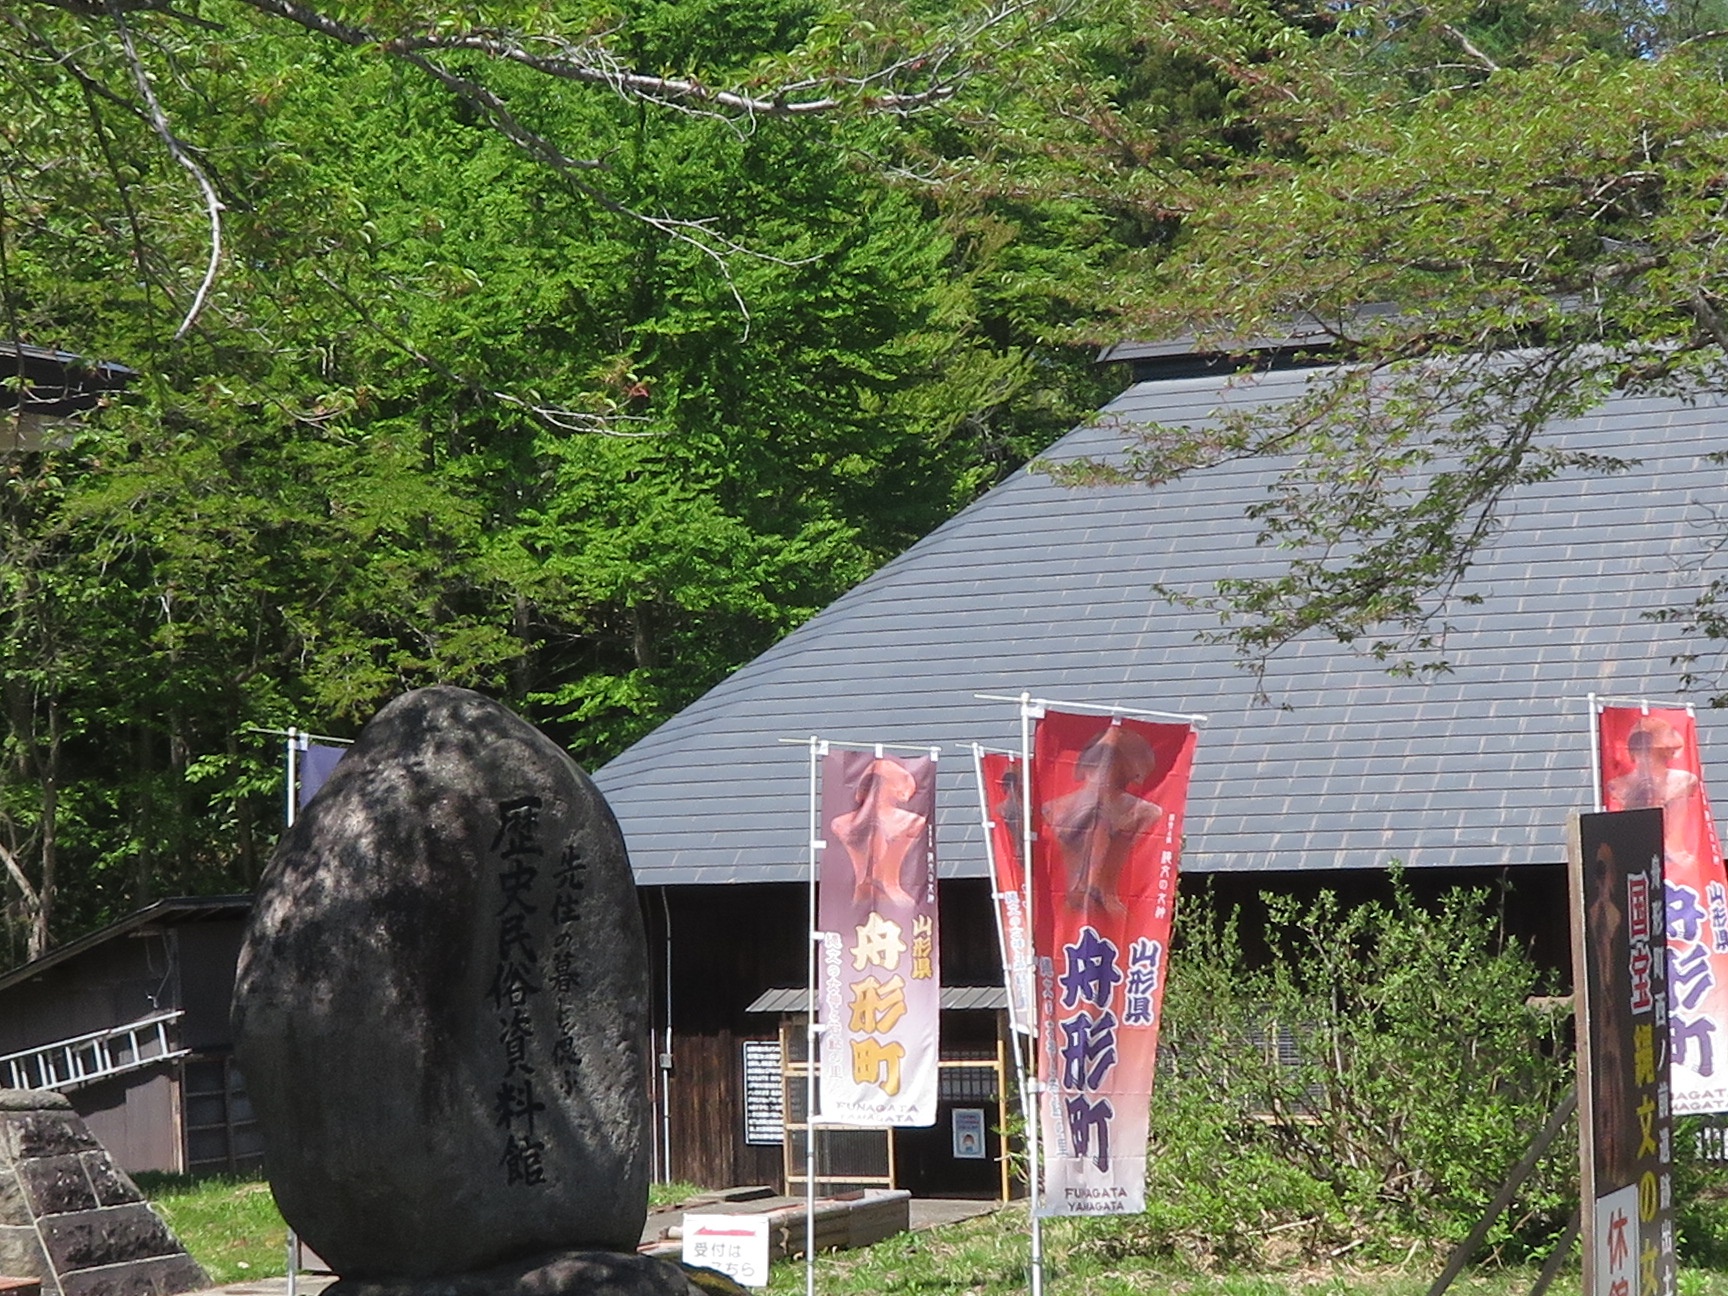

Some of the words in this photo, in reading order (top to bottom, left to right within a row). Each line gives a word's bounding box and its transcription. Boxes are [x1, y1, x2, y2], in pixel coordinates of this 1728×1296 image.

[486, 795, 547, 1188] 歴史民俗資料館
[849, 911, 909, 1098] 舟形町
[911, 914, 934, 980] 山形県
[1122, 935, 1163, 1028] 山形県
[1058, 924, 1123, 1175] 舟形町
[694, 1242, 741, 1258] 受付は
